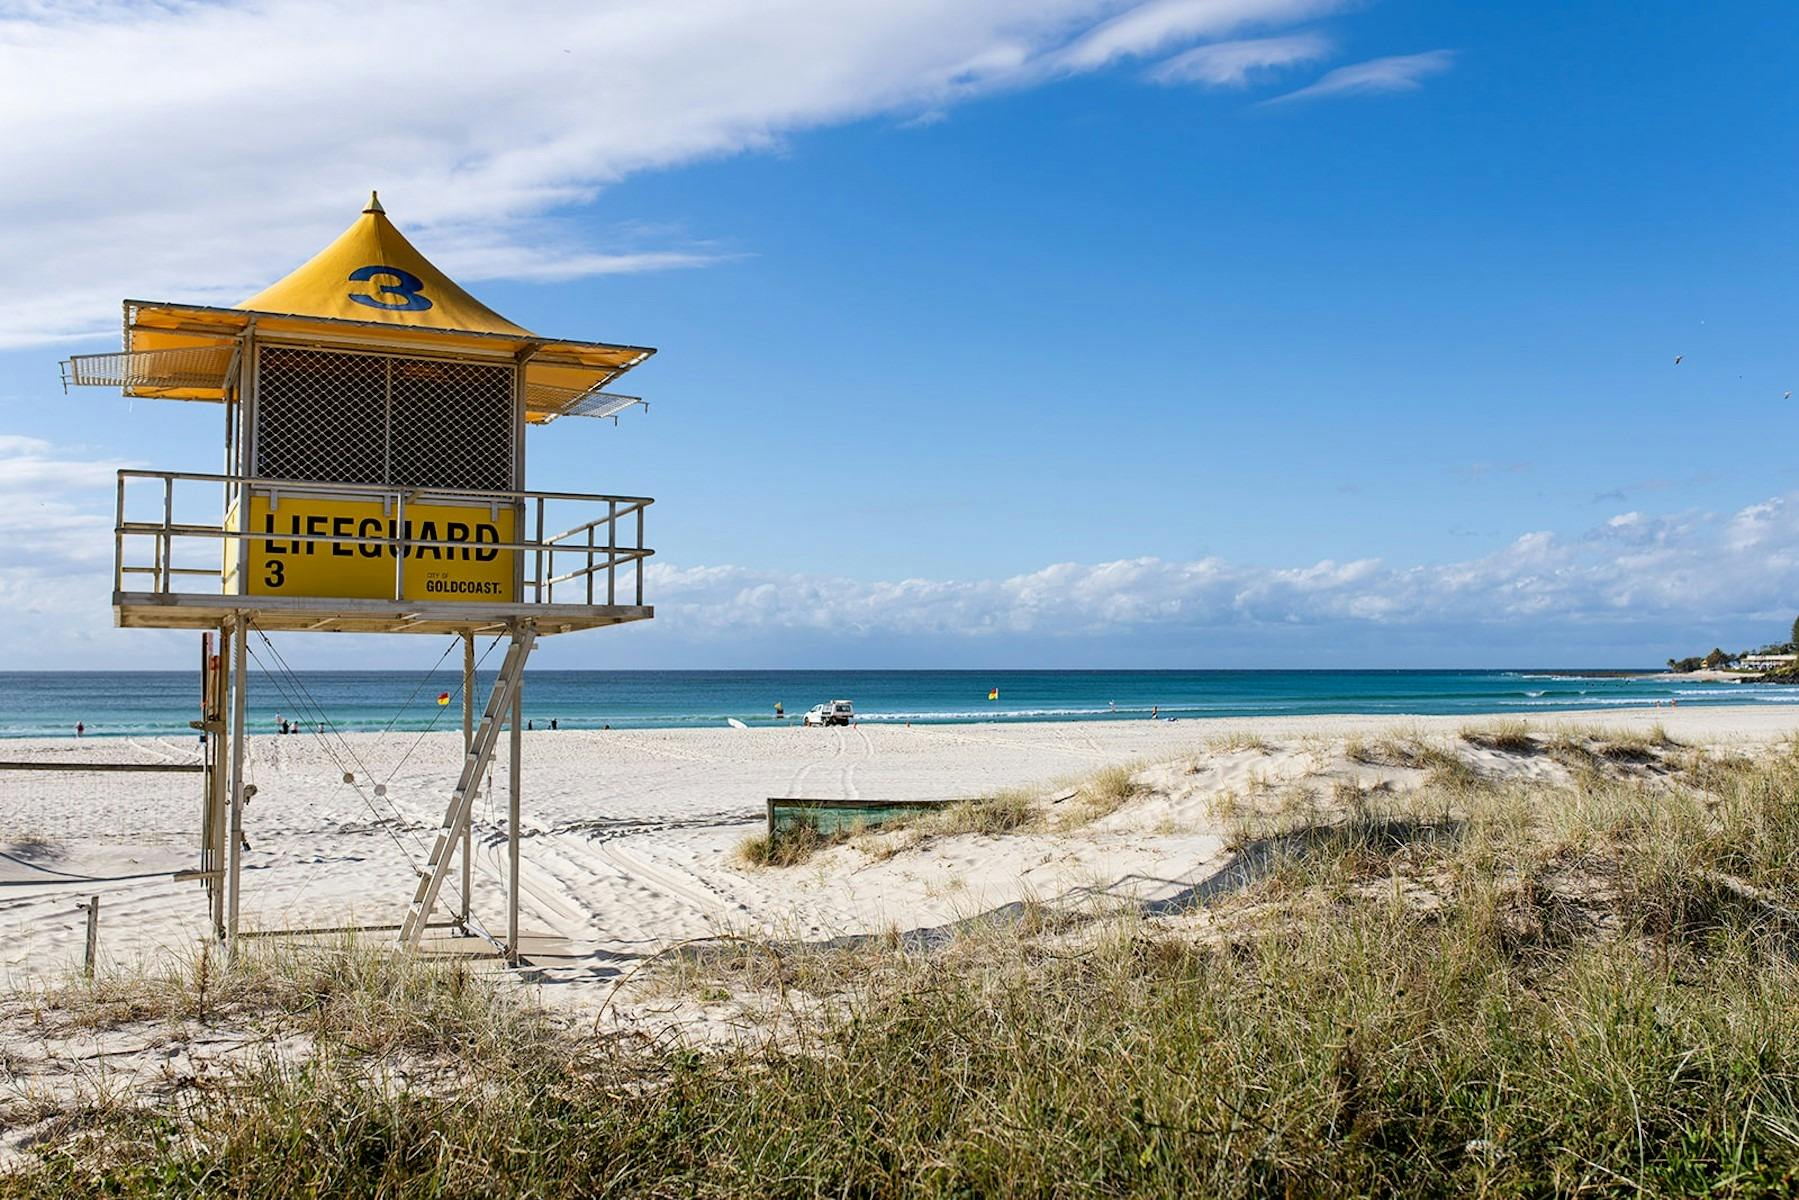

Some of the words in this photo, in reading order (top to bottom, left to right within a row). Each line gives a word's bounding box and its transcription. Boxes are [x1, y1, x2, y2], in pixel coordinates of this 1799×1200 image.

[348, 265, 433, 311] 3
[265, 514, 499, 562] LIFEGUARD
[264, 559, 285, 588] 3
[426, 580, 502, 594] GOLDCOAST.
